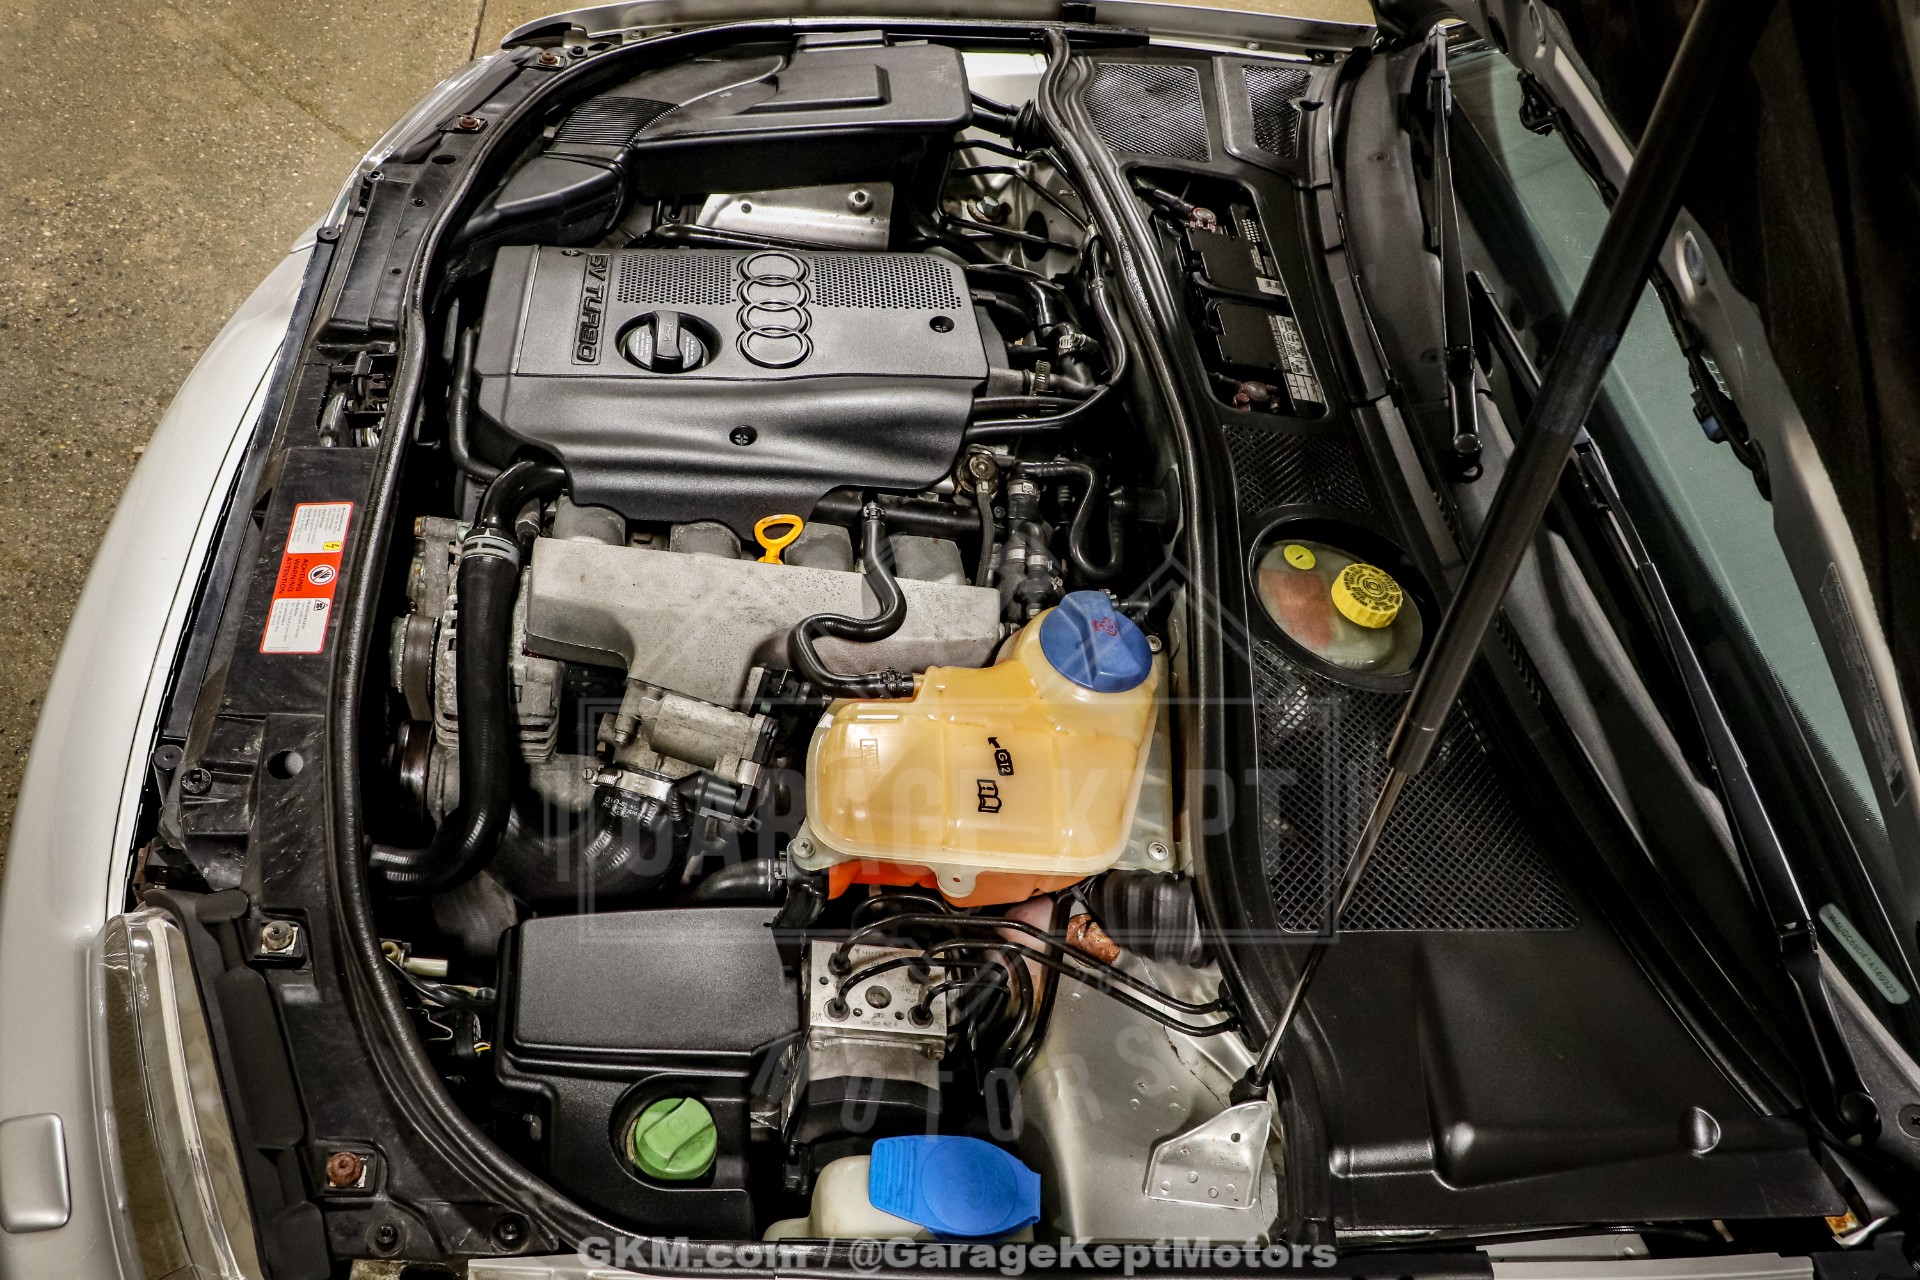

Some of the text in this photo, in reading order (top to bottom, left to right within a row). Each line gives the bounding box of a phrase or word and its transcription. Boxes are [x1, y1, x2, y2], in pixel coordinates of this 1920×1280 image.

[577, 254, 608, 362] 5V TURBO
[278, 556, 293, 594] ATTENTION
[286, 558, 301, 592] WARNING
[296, 558, 309, 592] ACHTUNG
[998, 752, 1011, 773] G12
